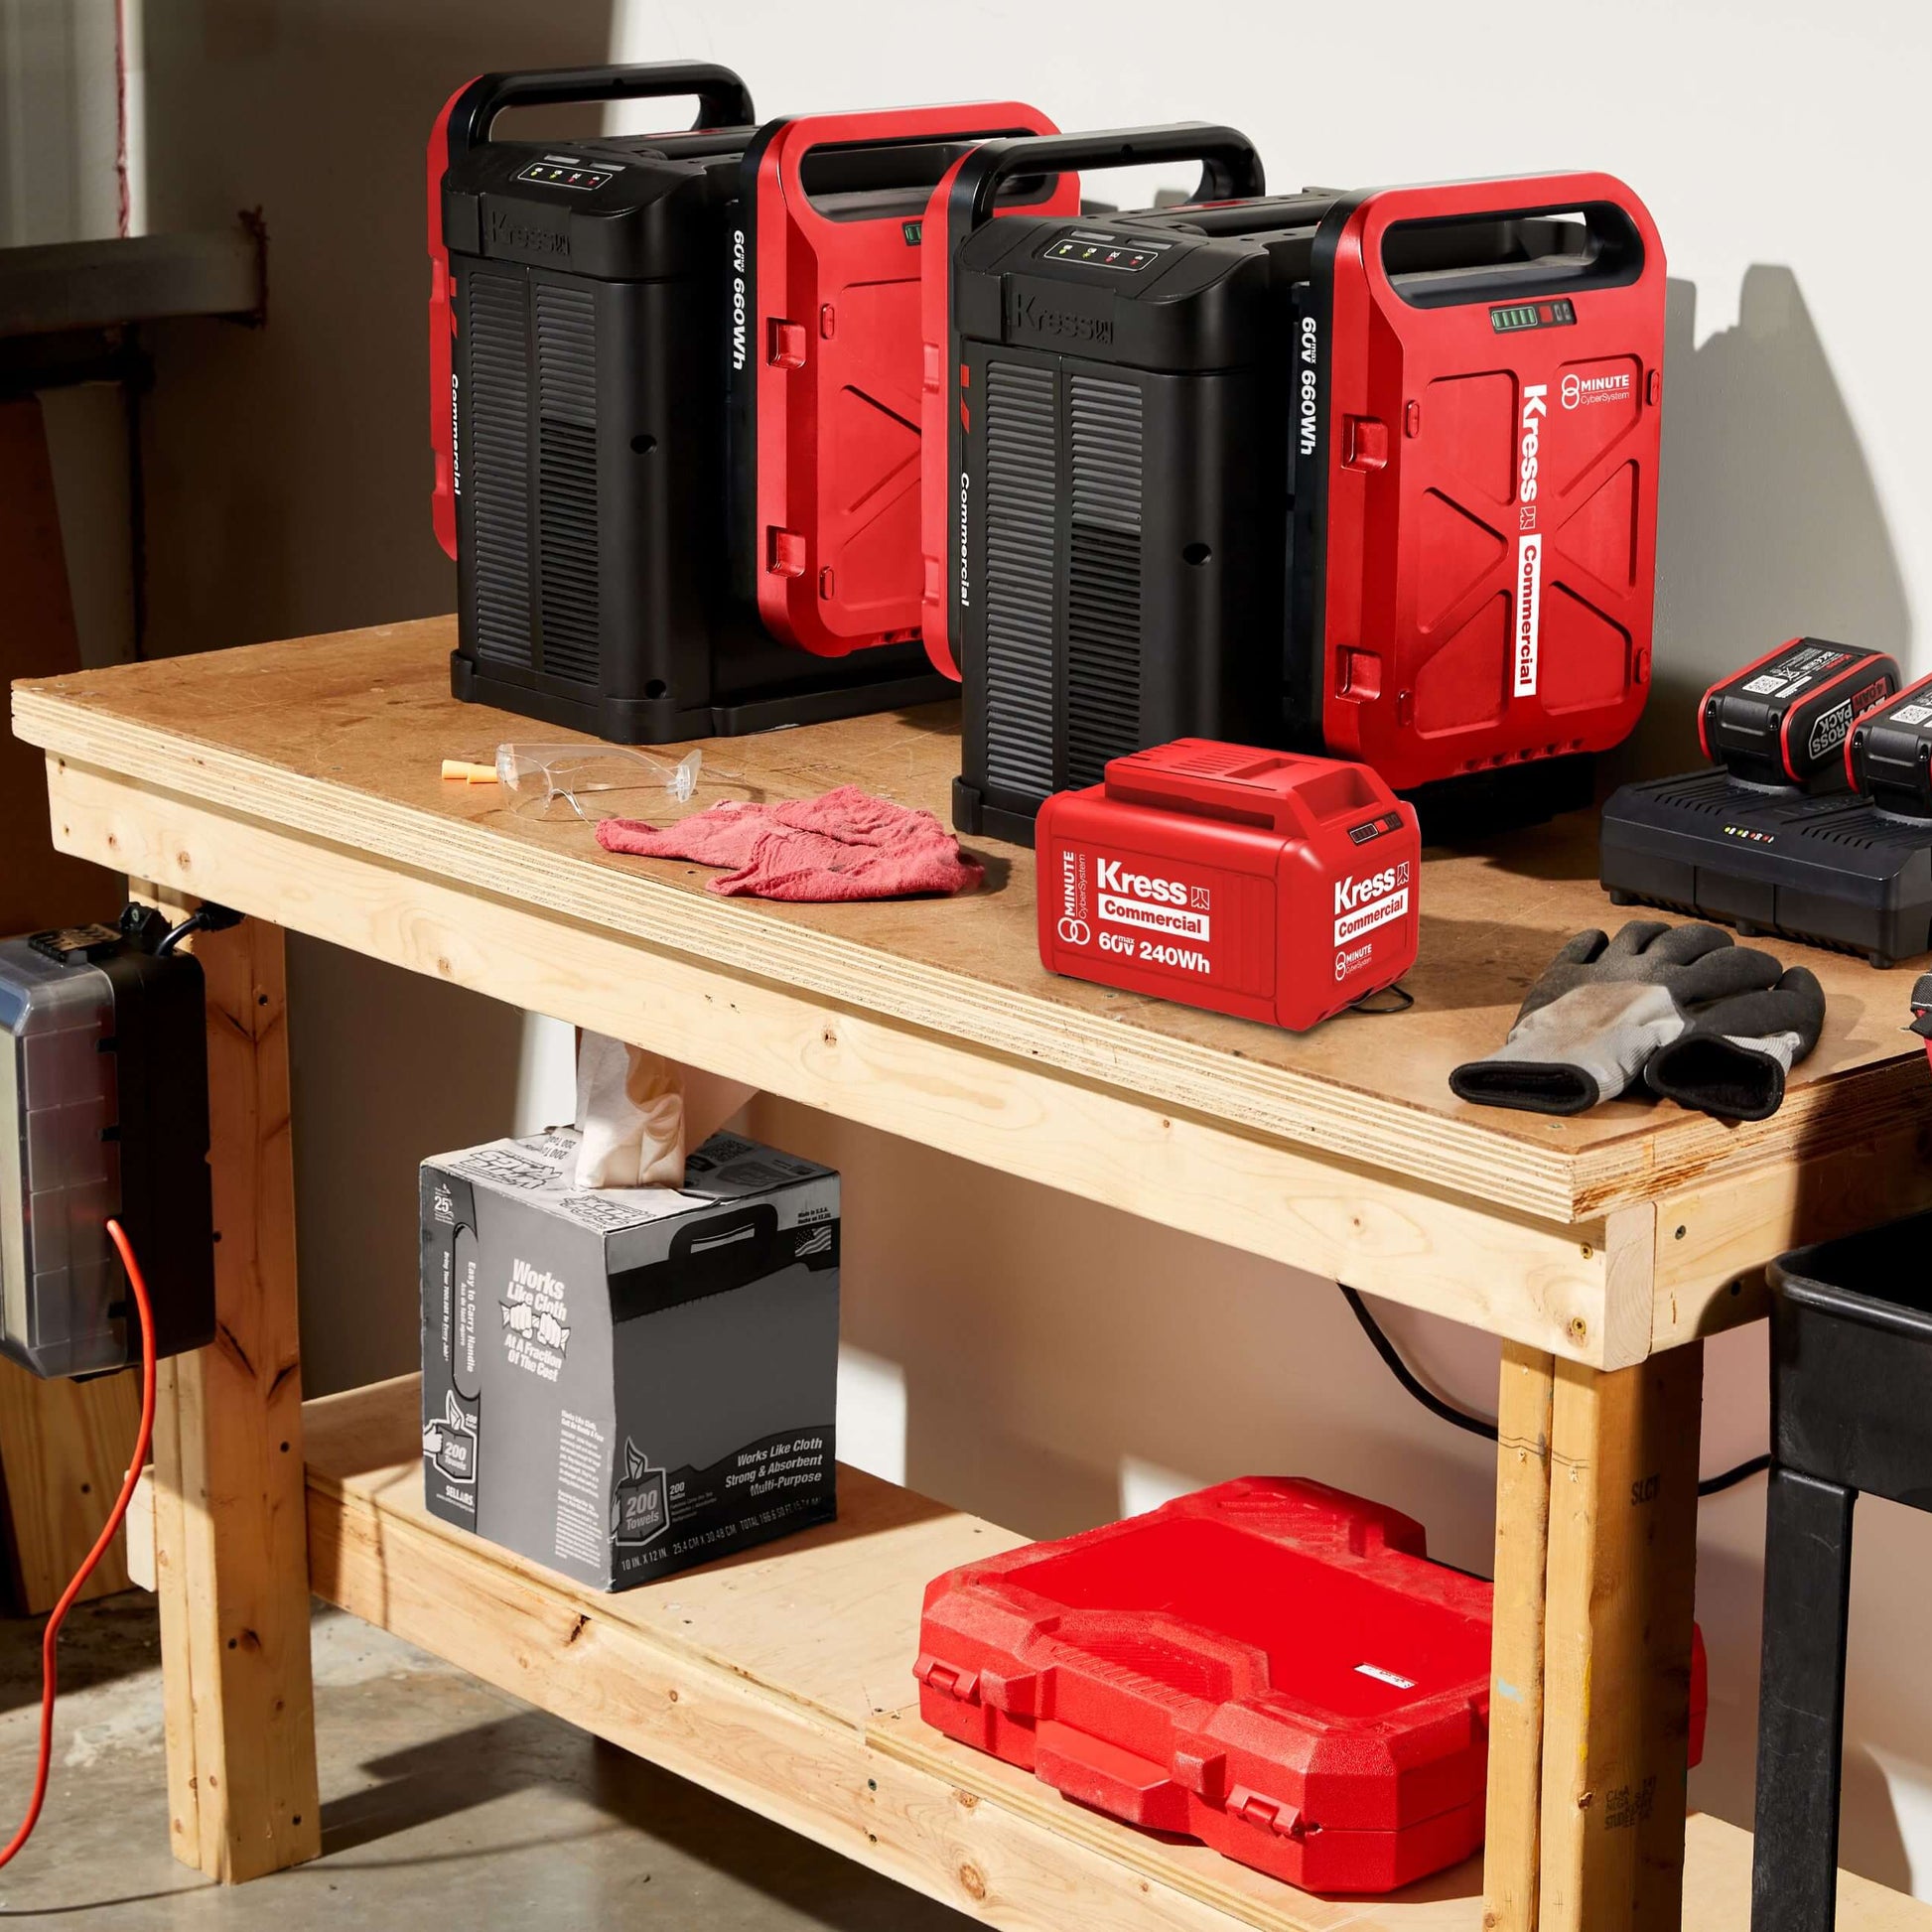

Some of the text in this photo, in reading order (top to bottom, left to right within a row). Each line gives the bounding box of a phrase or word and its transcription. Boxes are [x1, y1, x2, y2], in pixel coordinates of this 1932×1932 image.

[733, 277, 746, 370] 660Wh
[1581, 374, 1629, 392] MINUTE
[1581, 391, 1629, 405] CyberSystem
[1301, 369, 1316, 456] 660Wh
[452, 373, 461, 495] Commercial
[961, 472, 970, 607] Commercial
[1519, 384, 1548, 685] Kress Commercial
[1819, 704, 1853, 734] PACK
[1063, 851, 1075, 917] MINUTE
[1078, 854, 1088, 920] CyberSystem
[1097, 857, 1187, 905] Kress
[1334, 868, 1396, 915] Kress
[1104, 899, 1202, 933] Commercial
[1338, 895, 1404, 938] Commercial
[1139, 941, 1210, 974] 240Wh
[1345, 943, 1373, 963] MINUTE
[512, 1258, 565, 1300] Works
[466, 1261, 477, 1372] Easy to Carry Handle
[506, 1282, 567, 1321] Like Cloth
[504, 1333, 562, 1369] At A Fraction
[507, 1349, 559, 1382] Of The Cost
[444, 1442, 467, 1461] 200
[737, 1438, 823, 1467] Works Like Cloth
[669, 1481, 685, 1495] 200
[725, 1453, 823, 1488] Strong & Absorbent
[750, 1471, 822, 1497] Multi-Purpose
[625, 1489, 657, 1518] 200
[625, 1510, 659, 1531] Towels
[621, 1559, 630, 1572] 10
[648, 1551, 658, 1562] 12
[688, 1536, 700, 1549] CM
[725, 1524, 737, 1537] CM
[740, 1516, 759, 1531] TOTAL
